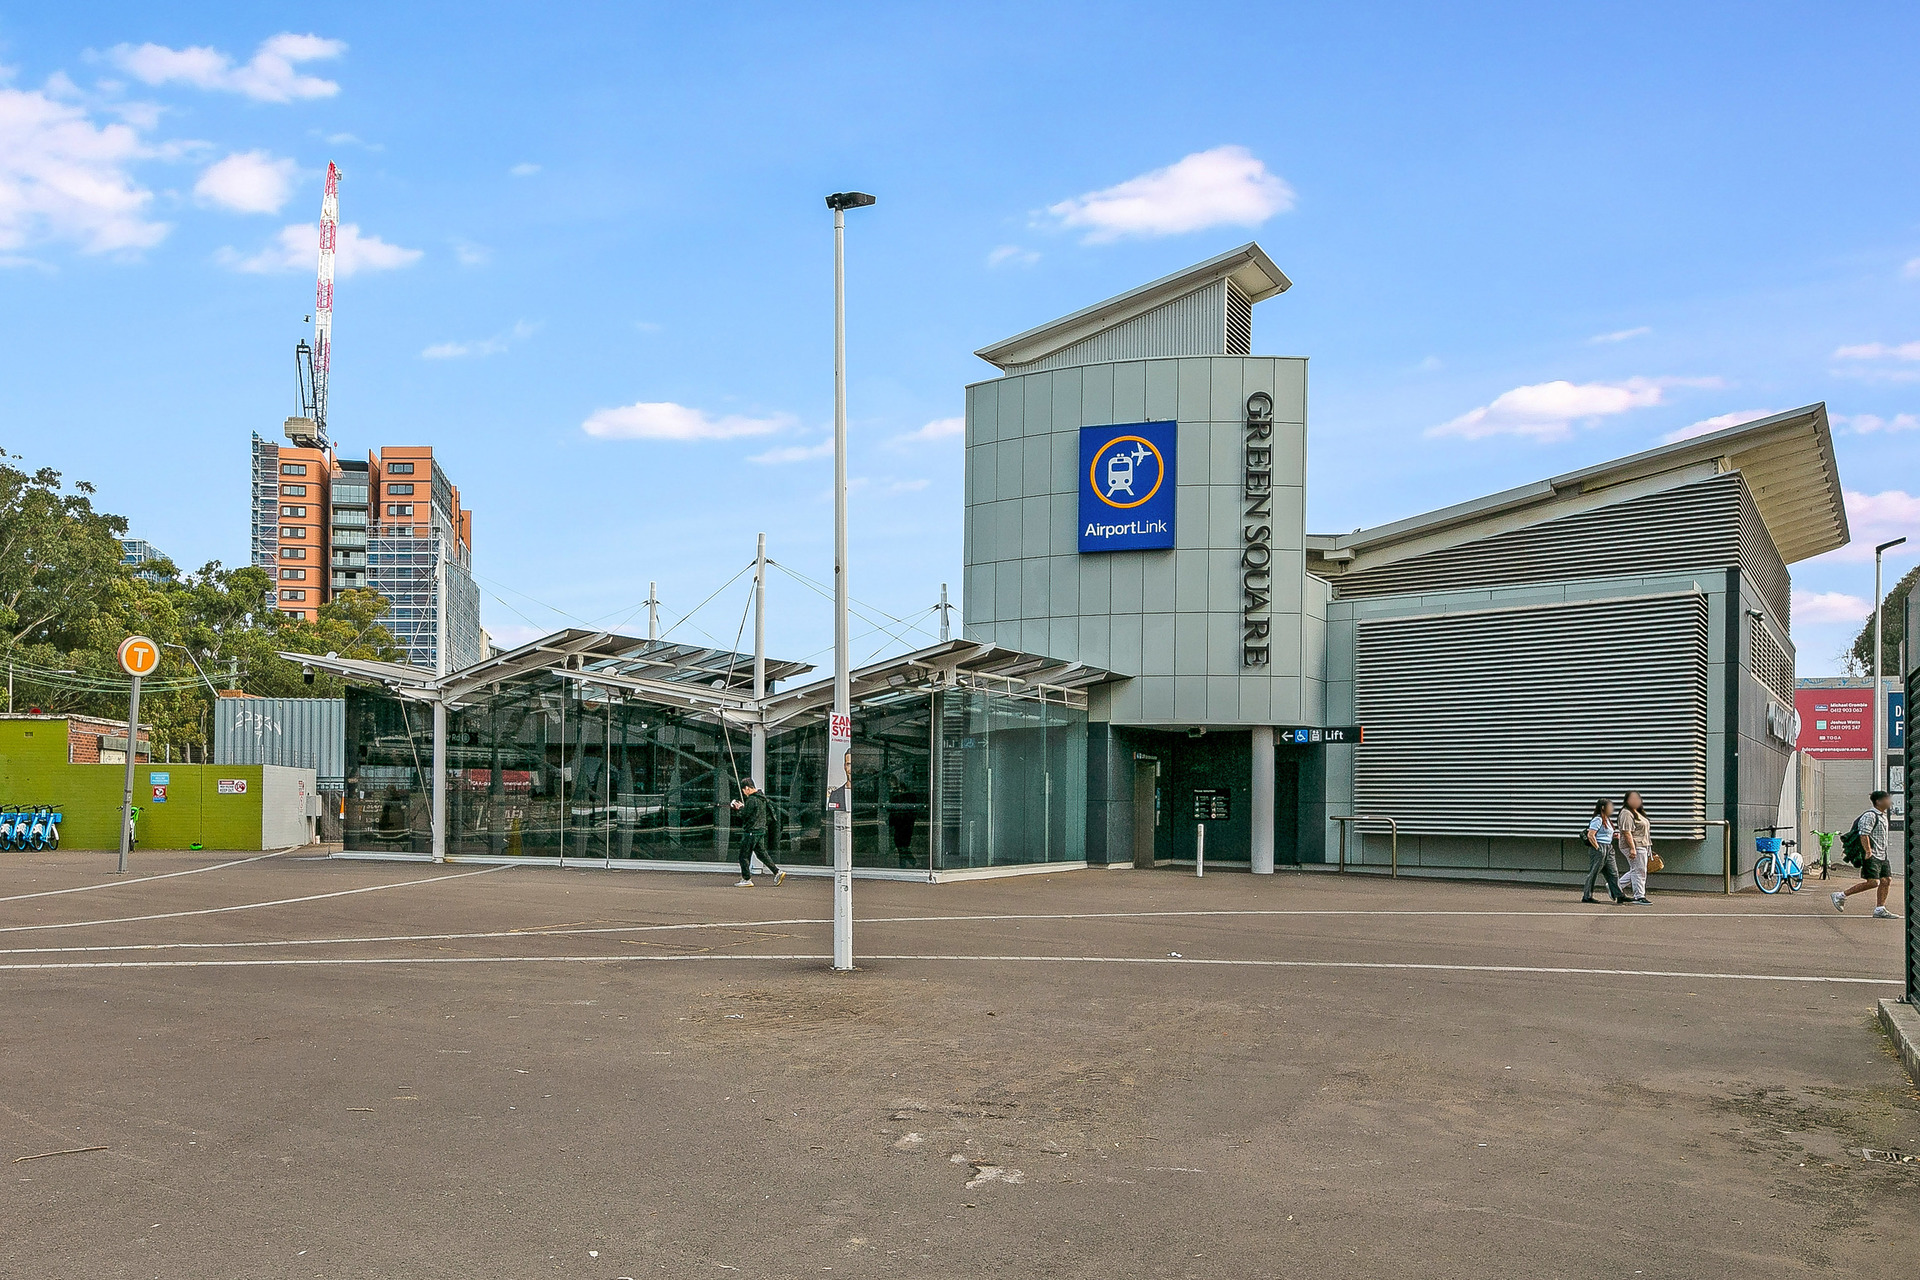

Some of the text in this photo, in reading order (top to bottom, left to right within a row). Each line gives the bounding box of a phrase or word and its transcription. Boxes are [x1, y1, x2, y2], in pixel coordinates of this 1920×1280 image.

[1085, 519, 1168, 539] AirportLink
[1241, 391, 1273, 667] GREEN SQUARE
[133, 647, 149, 668] T
[1325, 730, 1344, 740] Lift
